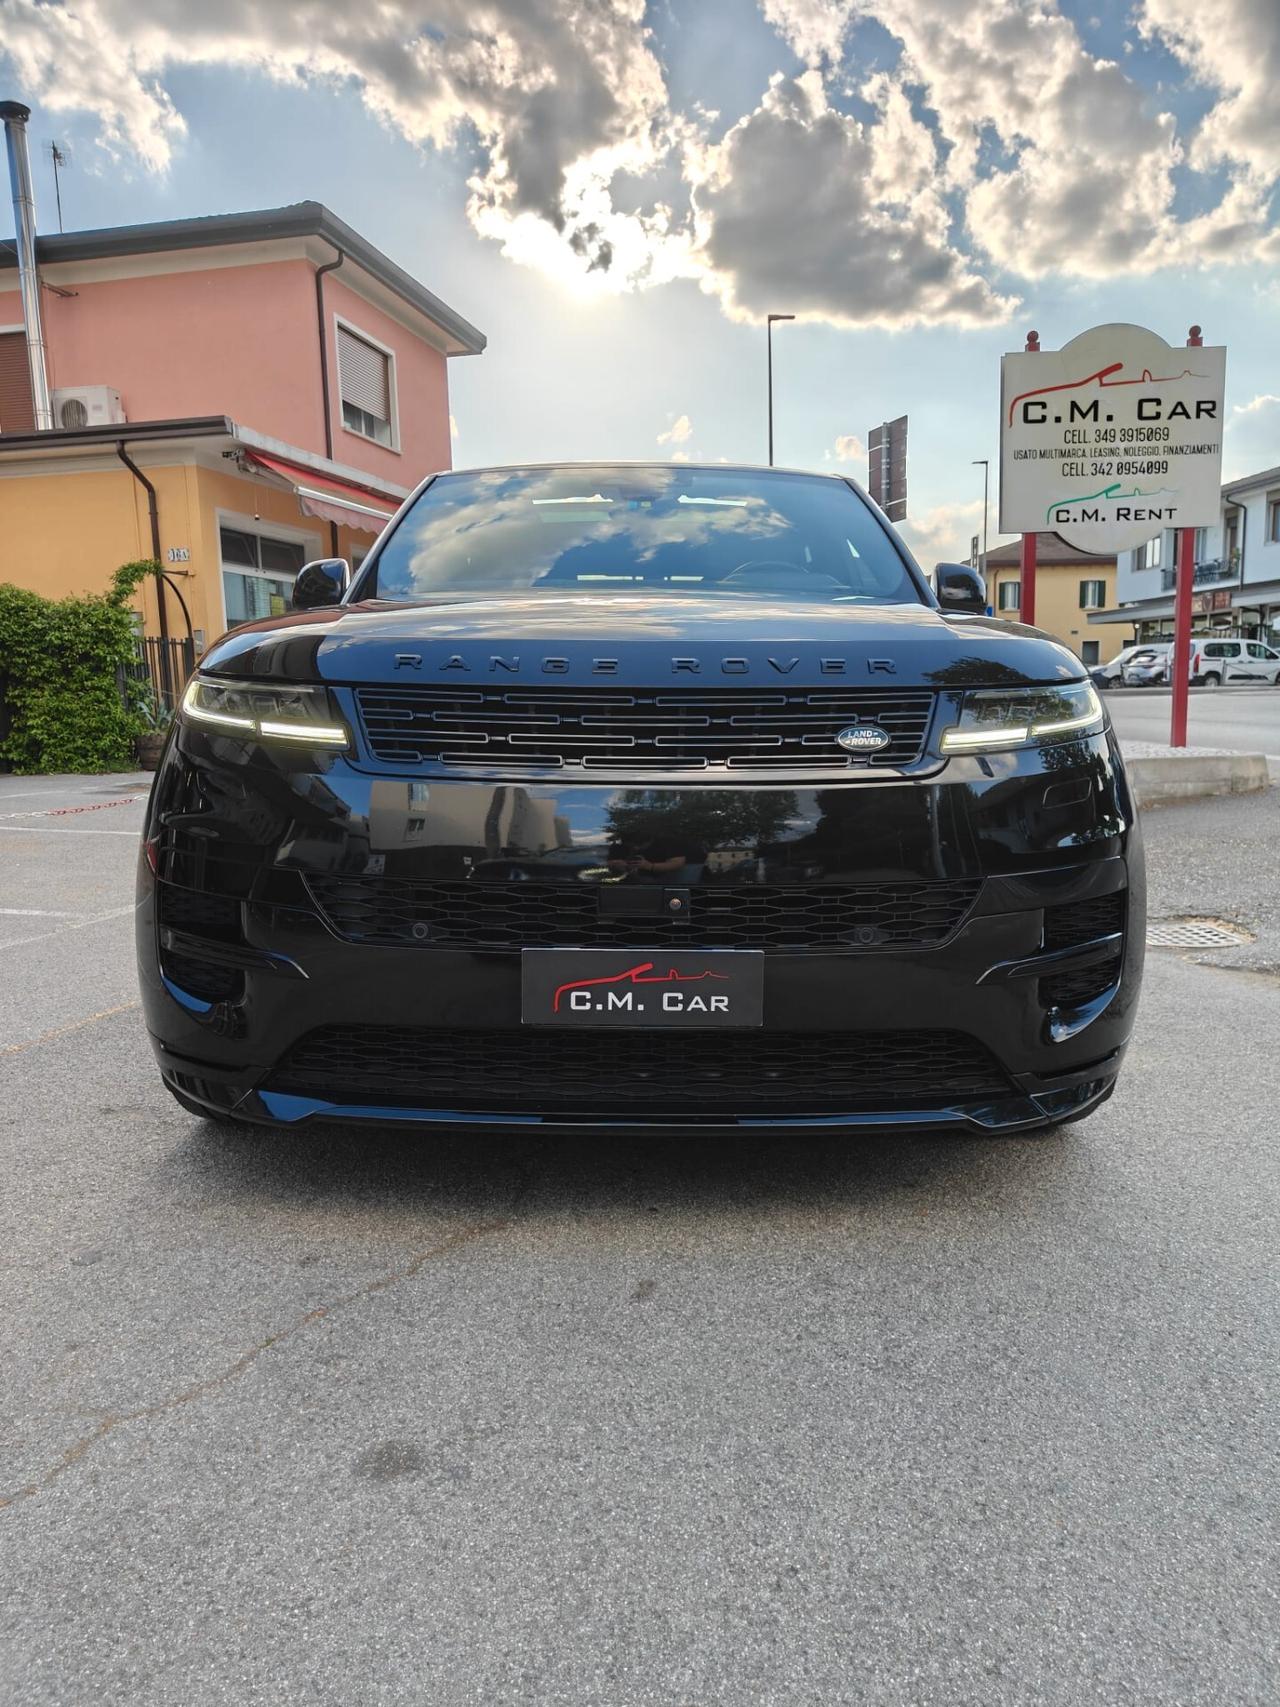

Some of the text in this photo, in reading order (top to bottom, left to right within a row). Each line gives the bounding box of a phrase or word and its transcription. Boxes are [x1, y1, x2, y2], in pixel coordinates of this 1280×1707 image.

[1023, 400, 1113, 423] C.M.
[1064, 427, 1170, 444] CELL. 349 3915069
[1014, 449, 1038, 460] USATO
[1163, 443, 1219, 456] FINANZIAMENTI
[1062, 460, 1169, 477] CELL. 342 0954099
[1055, 508, 1106, 523] C.M.
[393, 653, 897, 675] RANGE ROVER
[570, 991, 645, 1011] C.M.
